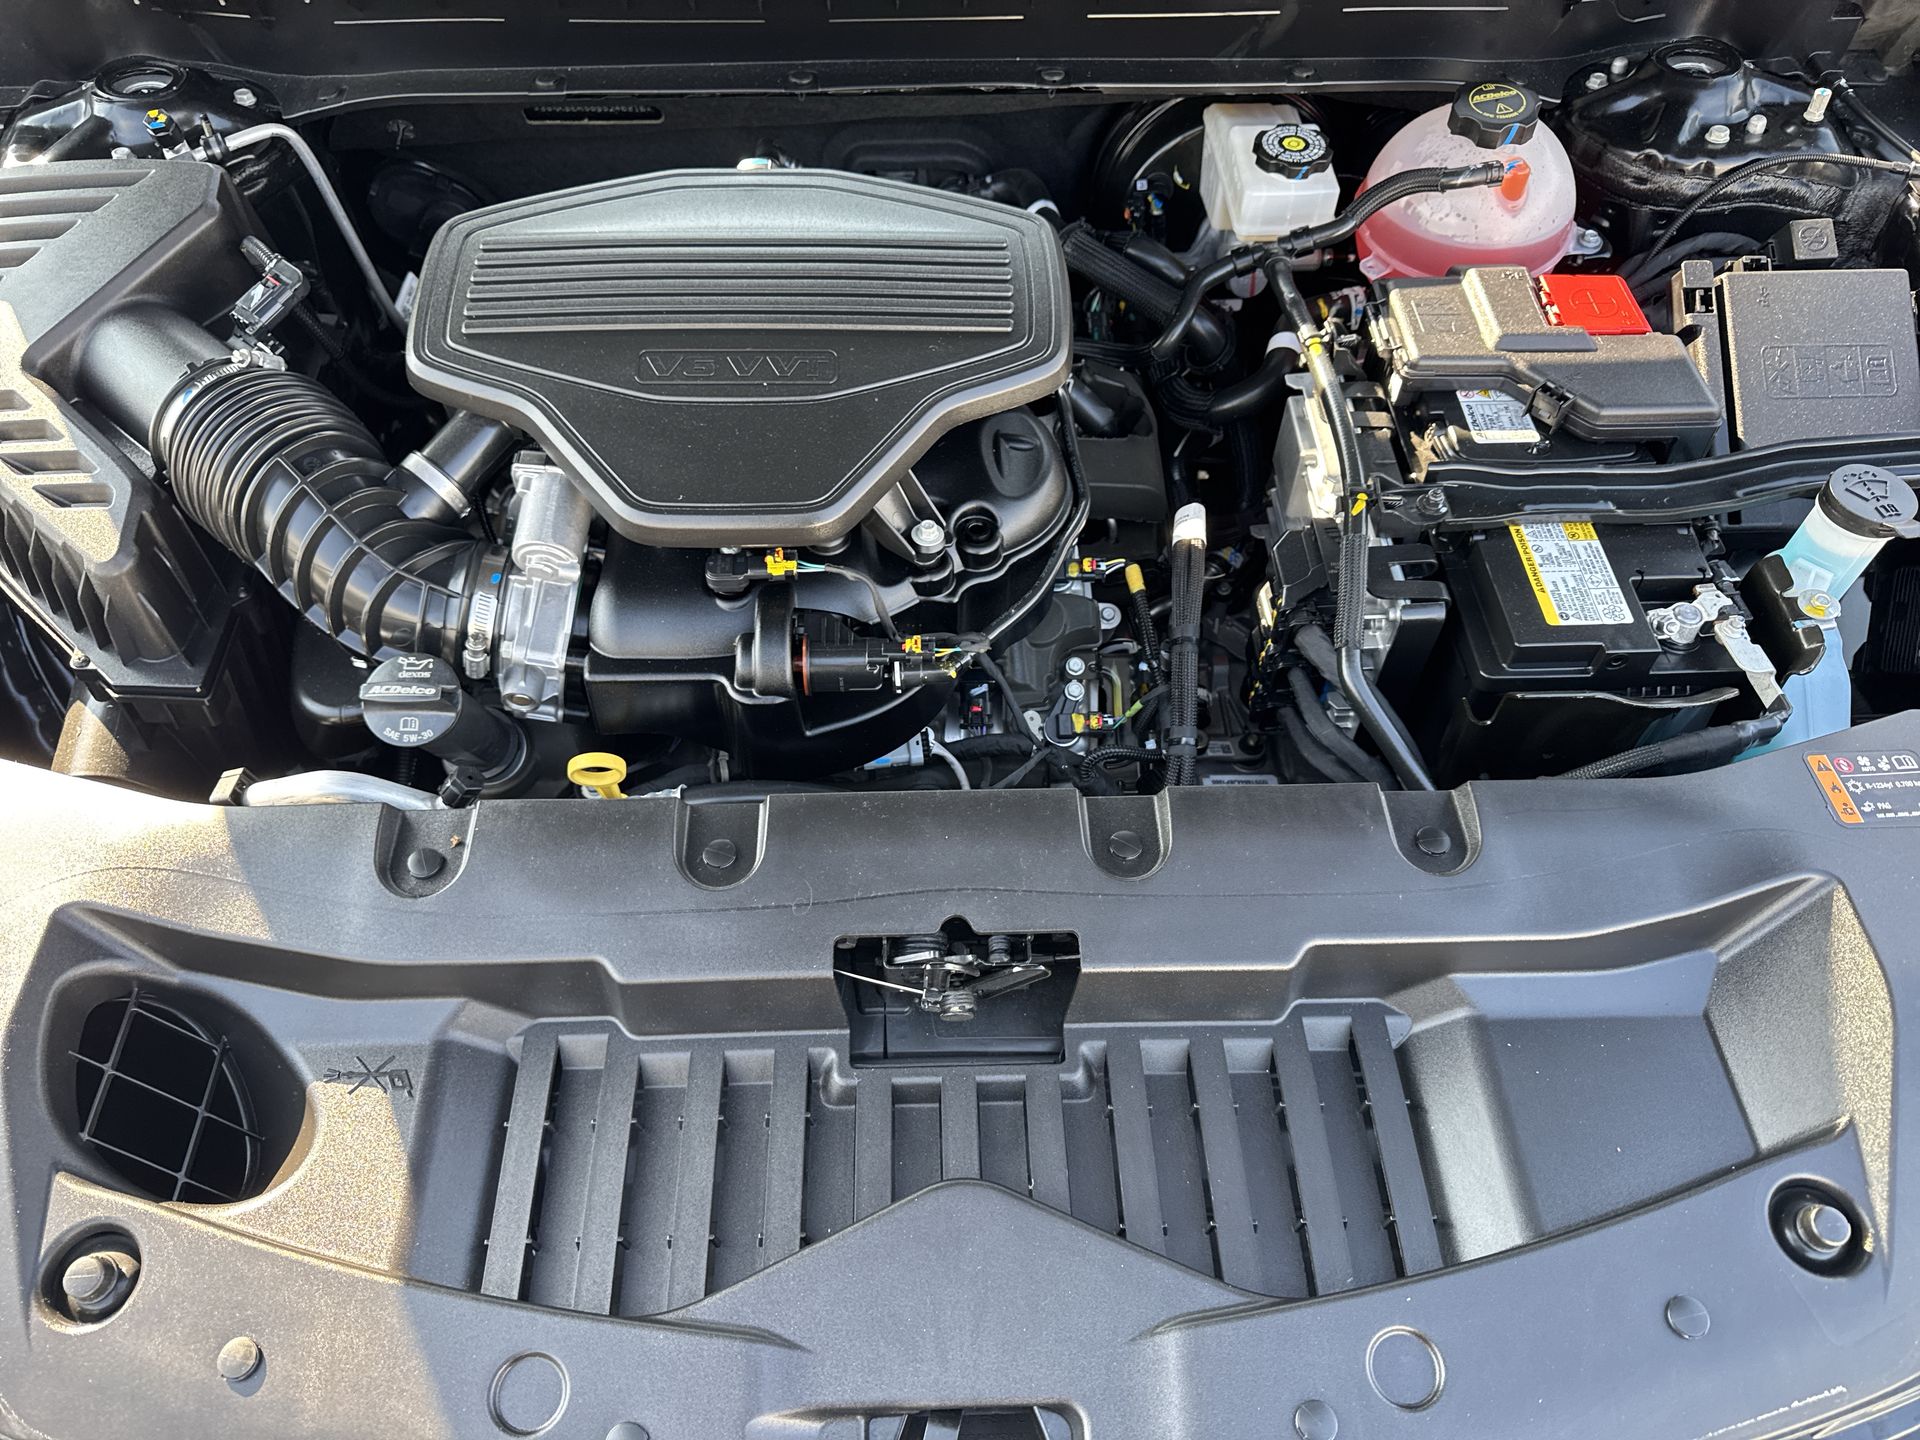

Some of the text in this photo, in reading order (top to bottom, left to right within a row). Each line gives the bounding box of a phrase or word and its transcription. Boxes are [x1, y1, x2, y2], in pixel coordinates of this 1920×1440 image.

[1473, 90, 1517, 102] ACDelco
[645, 355, 830, 377] V6 VVT
[398, 670, 432, 678] dexos
[368, 685, 436, 695] ACDelco
[383, 727, 434, 743] SAE 5W-30
